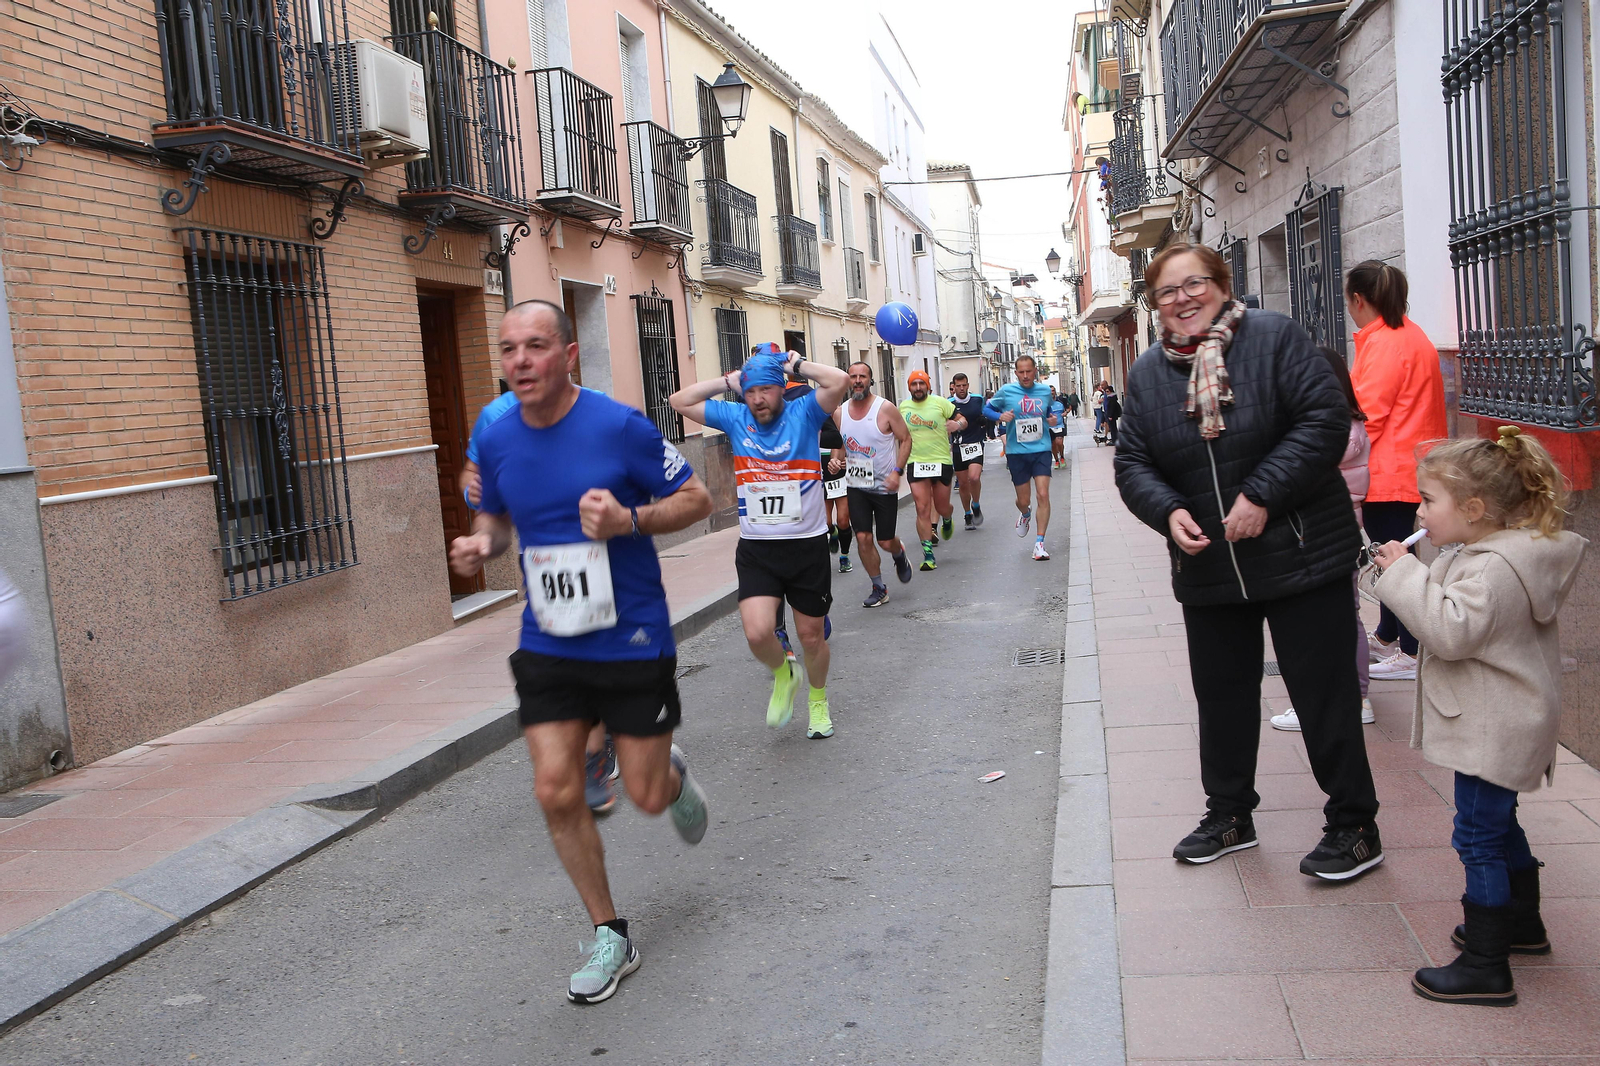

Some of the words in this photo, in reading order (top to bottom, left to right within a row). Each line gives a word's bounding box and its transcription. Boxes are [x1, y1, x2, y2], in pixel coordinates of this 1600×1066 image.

[443, 241, 453, 260] 44
[487, 271, 503, 292] 44
[606, 276, 617, 292] 42
[1021, 424, 1038, 434] 238
[964, 445, 978, 455] 693
[827, 480, 841, 491] 417
[758, 495, 785, 515] 177
[541, 569, 589, 602] 961
